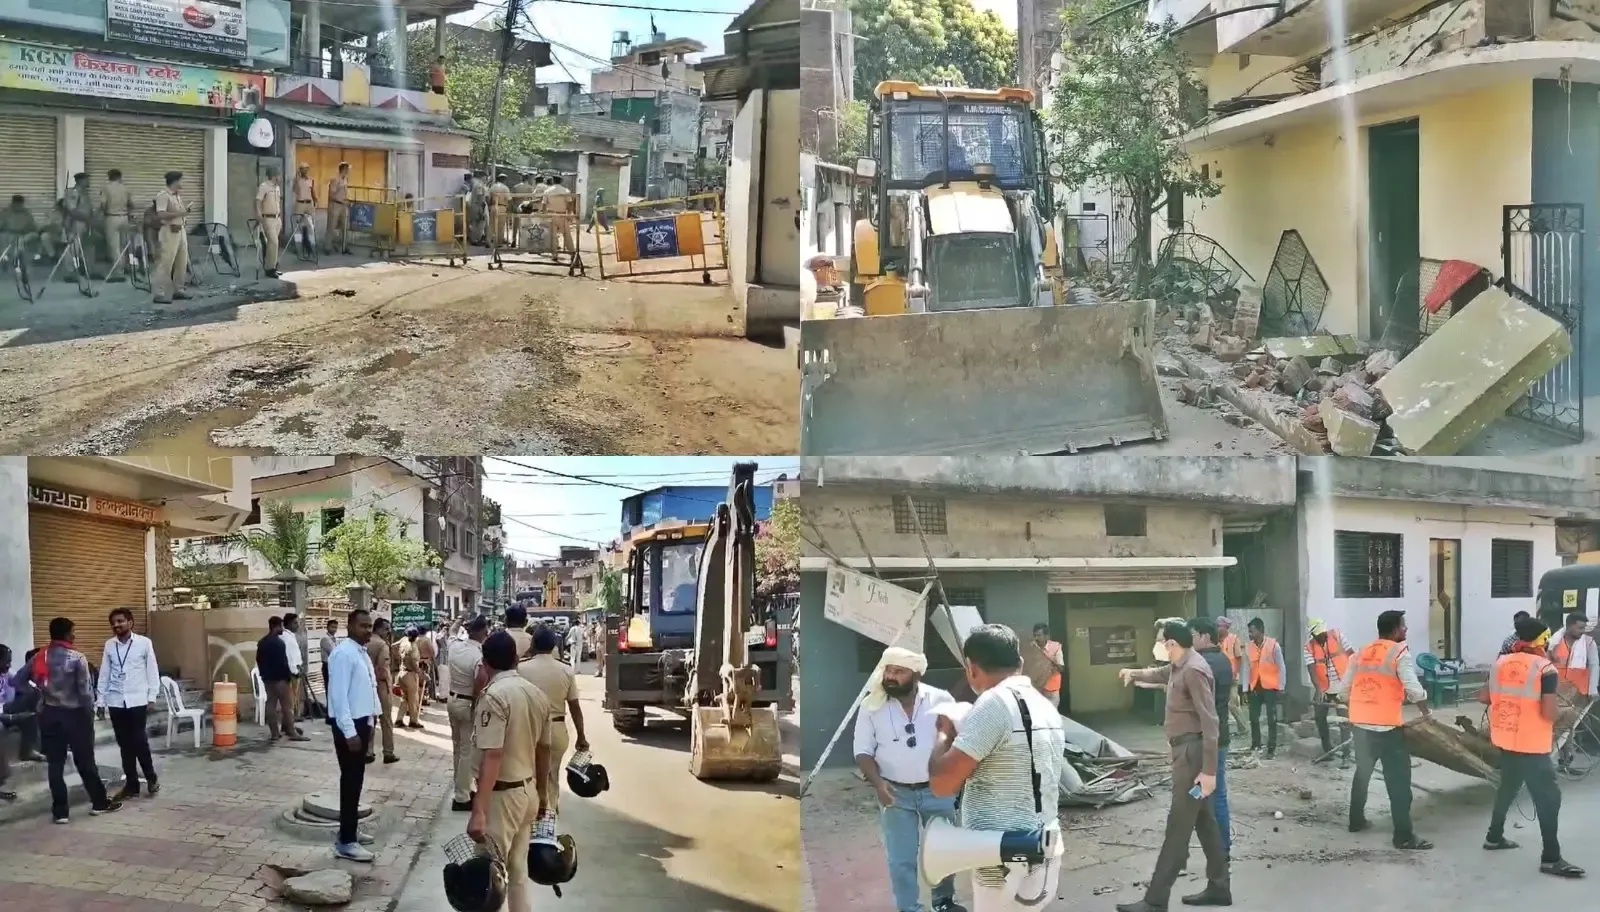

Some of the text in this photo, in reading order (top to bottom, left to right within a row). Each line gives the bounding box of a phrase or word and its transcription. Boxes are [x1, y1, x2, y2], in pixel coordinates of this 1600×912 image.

[20, 47, 68, 66] KGN
[72, 51, 181, 80] किराना स्टोर
